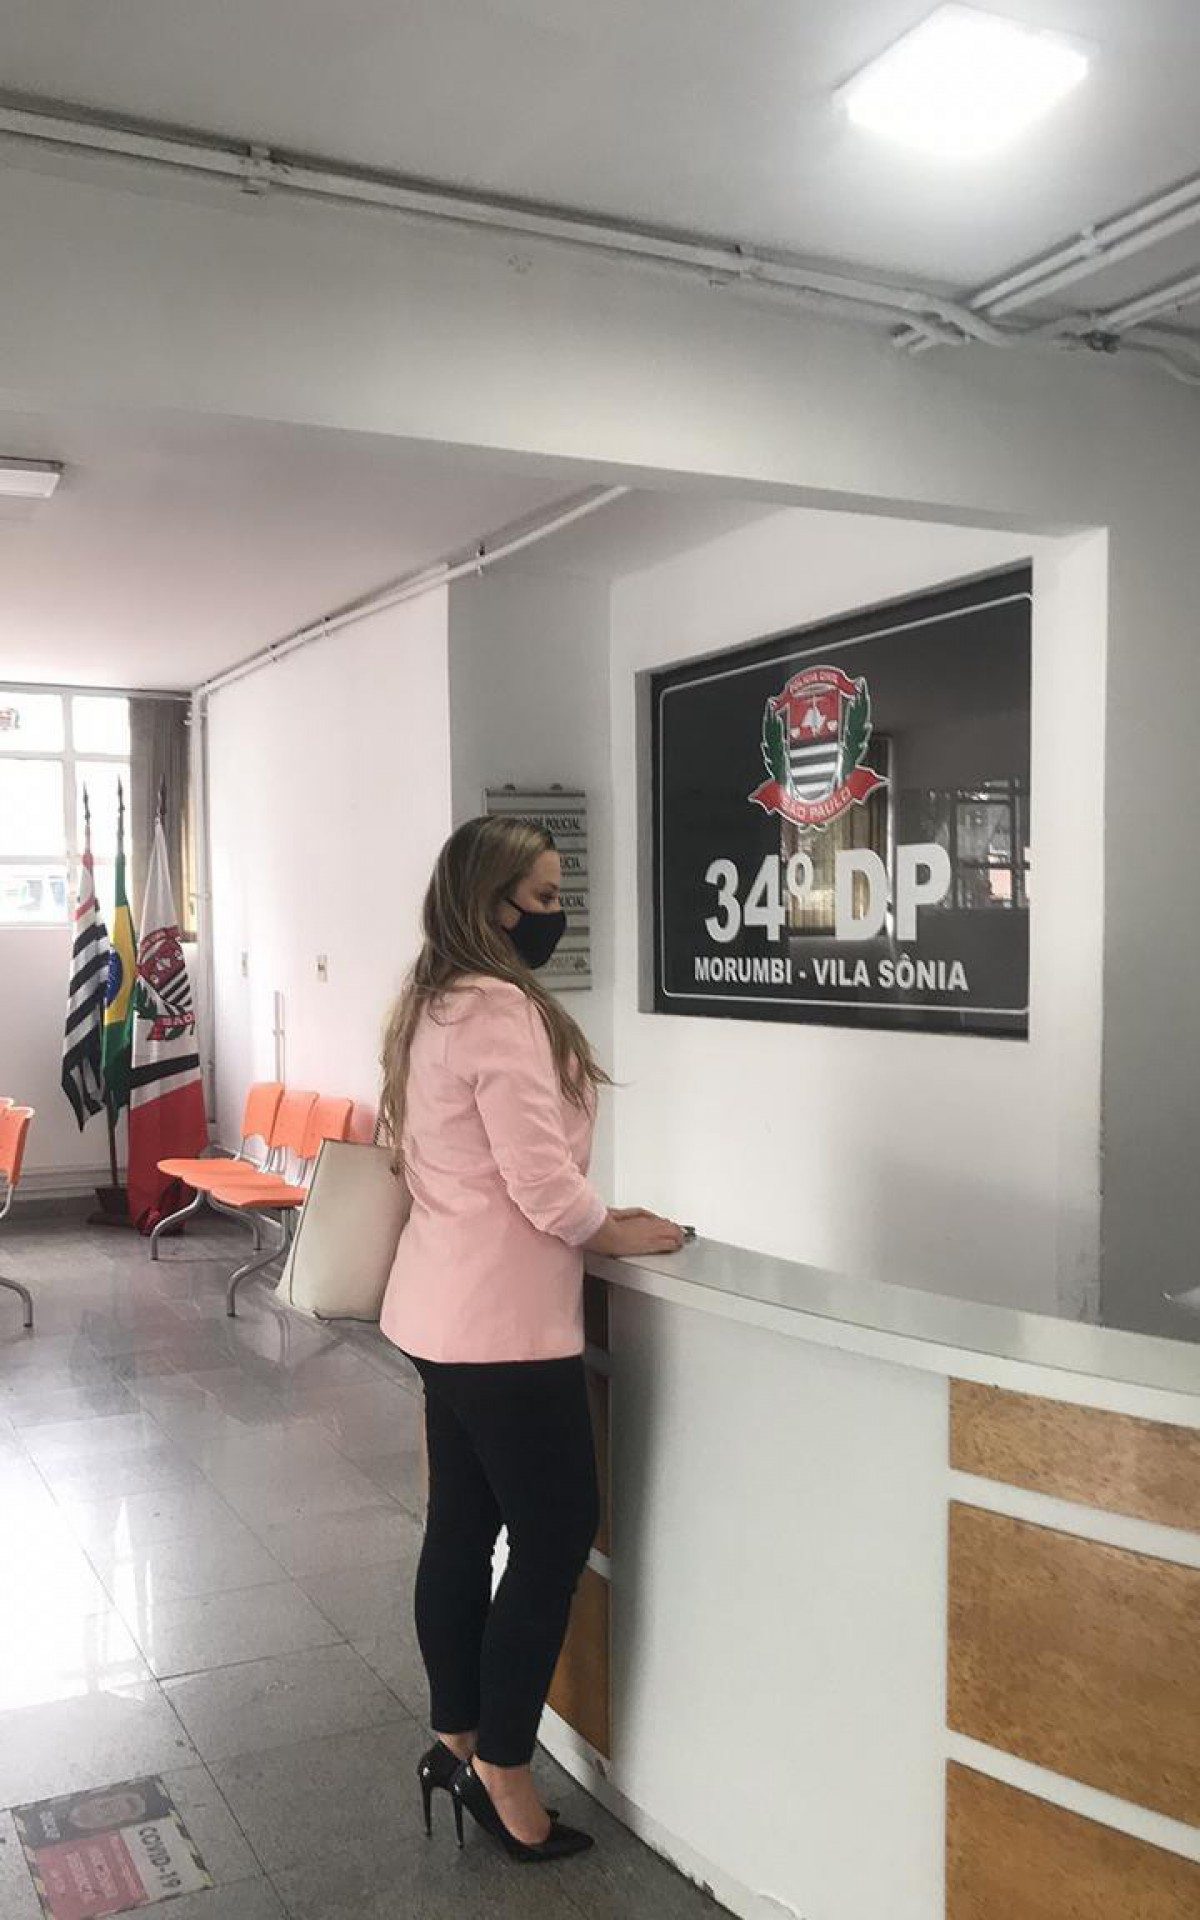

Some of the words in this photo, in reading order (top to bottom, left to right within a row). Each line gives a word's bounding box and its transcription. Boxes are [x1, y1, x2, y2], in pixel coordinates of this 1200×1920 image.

[834, 842, 951, 941] DP
[694, 955, 793, 985] MORUMBI
[812, 957, 870, 988] VILA
[877, 952, 970, 992] SÔNIA
[139, 1825, 182, 1888] COVID-19
